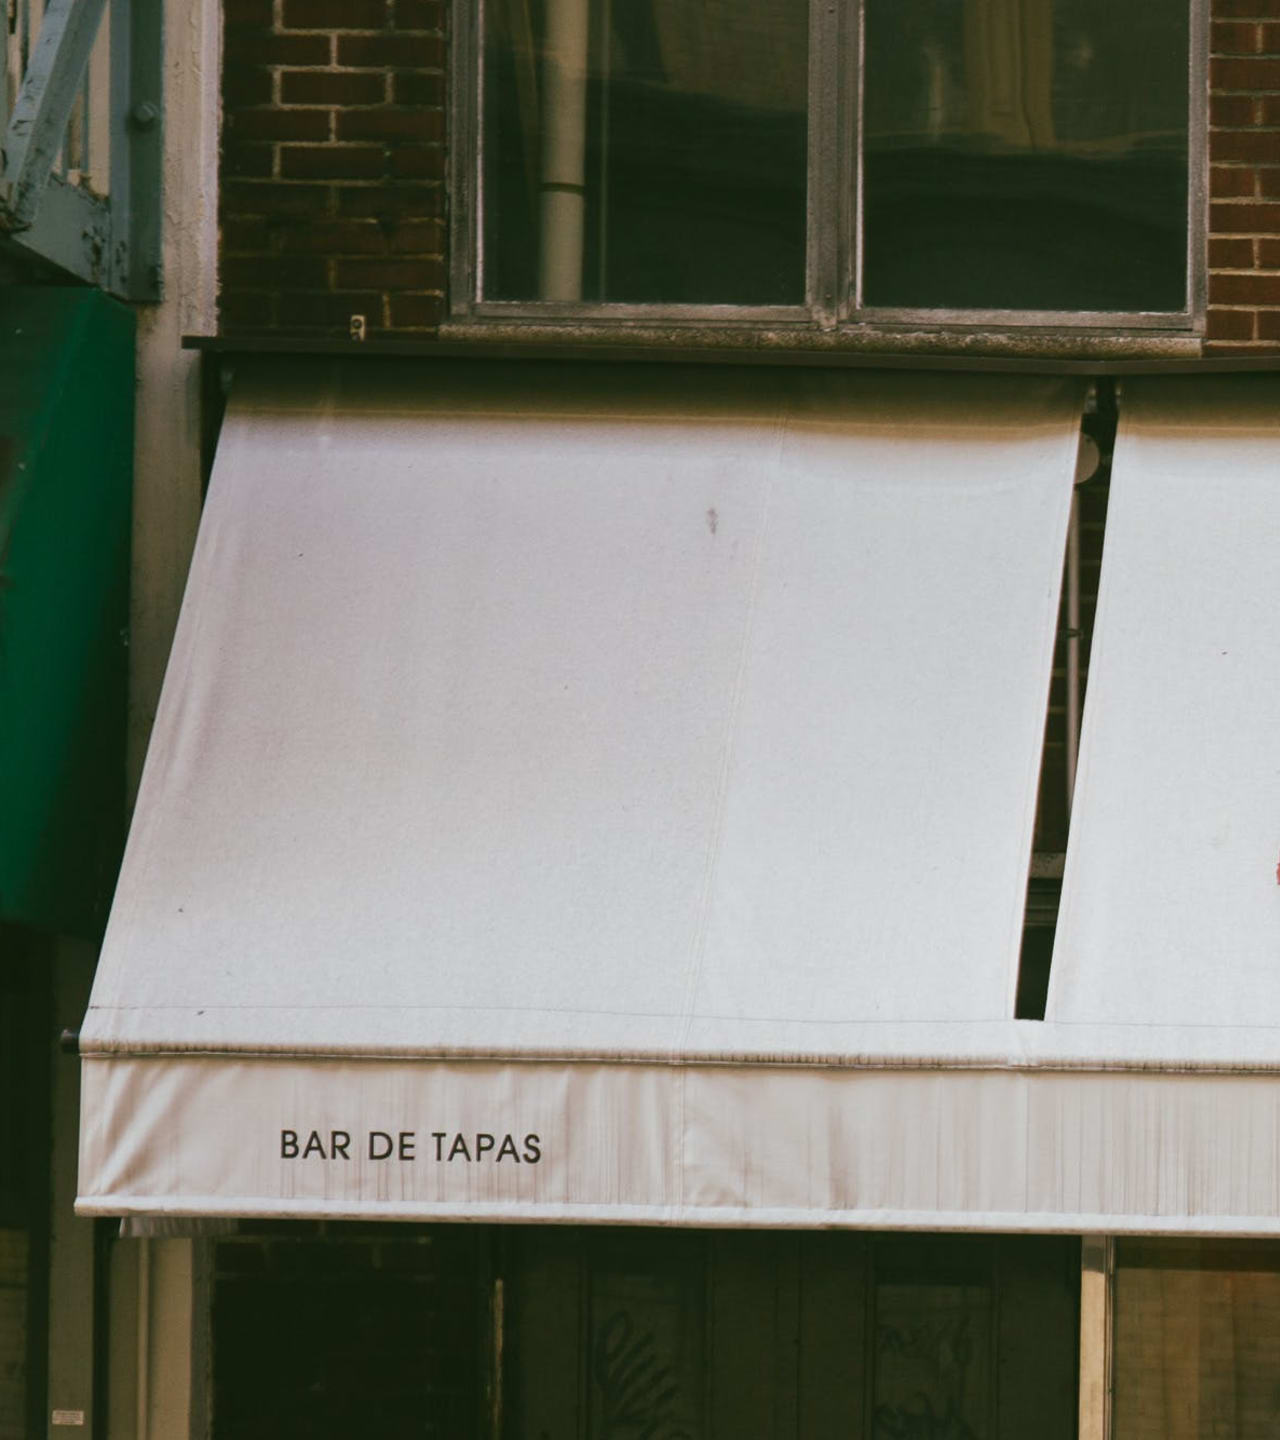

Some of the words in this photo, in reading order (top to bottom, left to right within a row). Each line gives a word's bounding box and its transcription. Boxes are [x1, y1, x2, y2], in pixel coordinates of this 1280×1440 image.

[280, 1129, 351, 1160] BAR
[368, 1131, 416, 1161] DE
[431, 1132, 542, 1164] TAPAS
